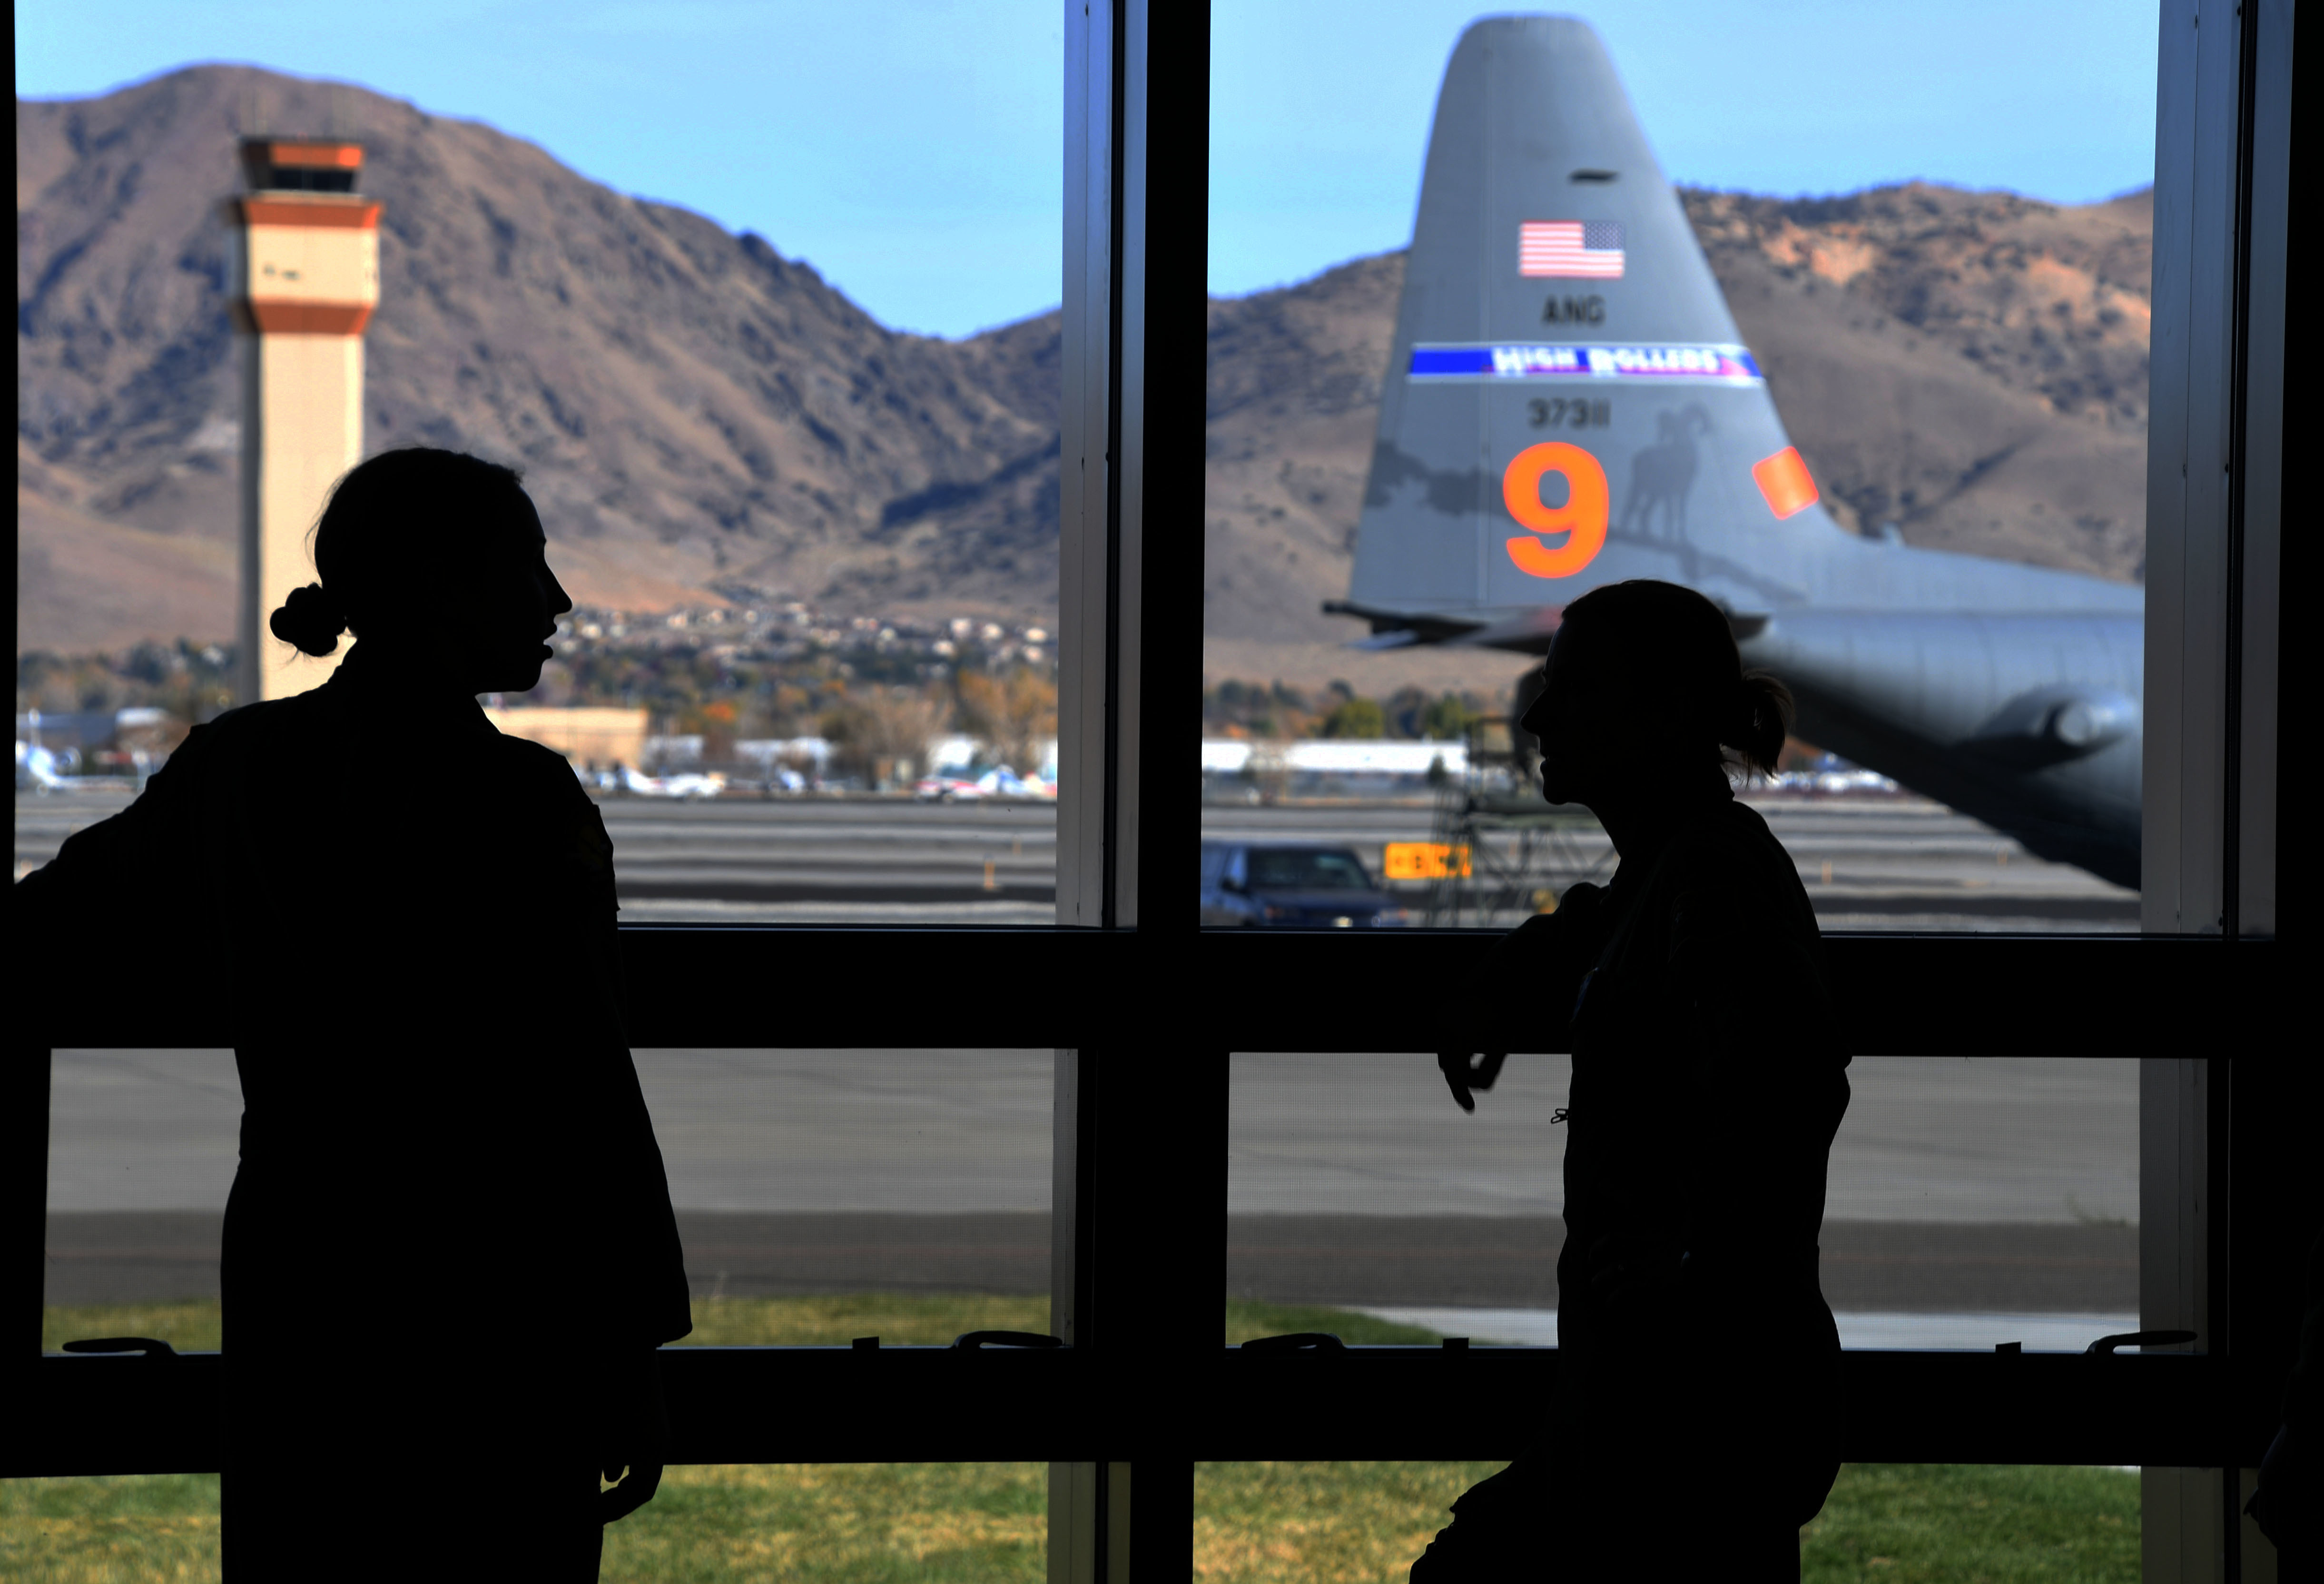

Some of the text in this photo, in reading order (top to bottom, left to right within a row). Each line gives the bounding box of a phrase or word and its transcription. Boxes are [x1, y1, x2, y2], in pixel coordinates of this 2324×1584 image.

[1541, 295, 1605, 324] ANG
[1528, 398, 1611, 428] 37311
[1503, 442, 1609, 578] 9
